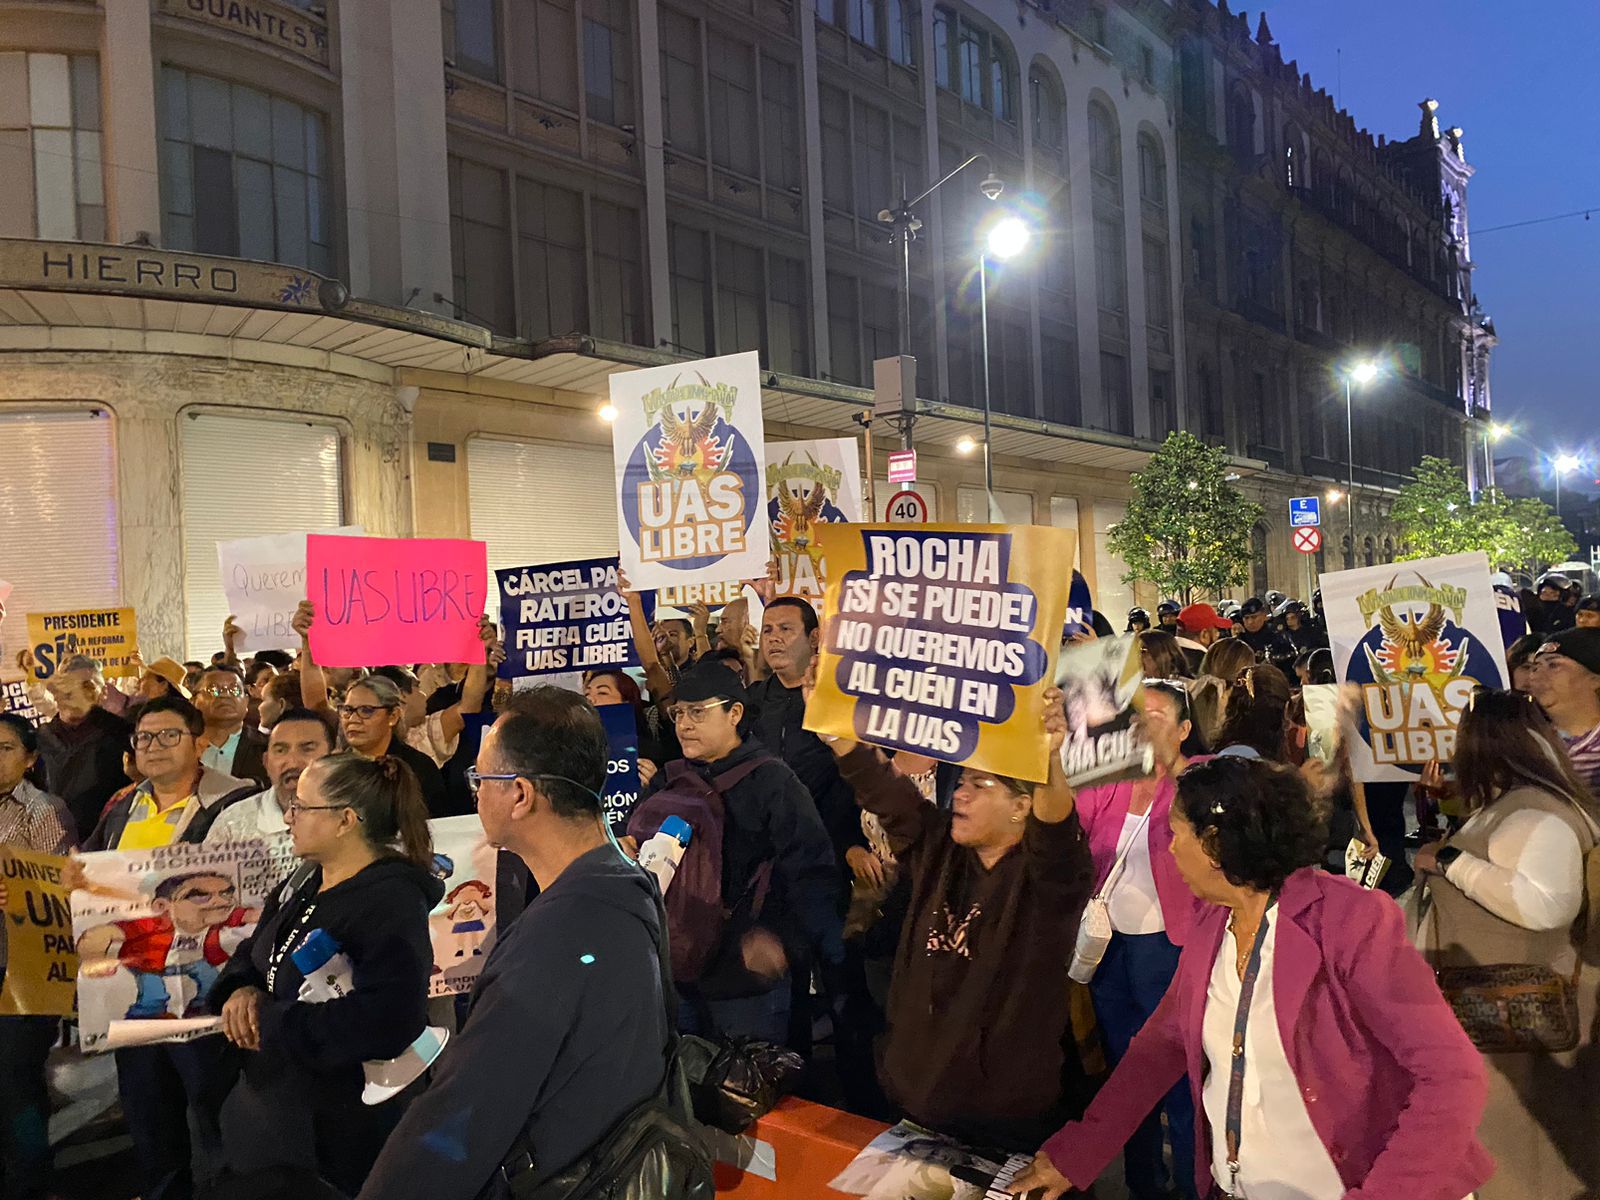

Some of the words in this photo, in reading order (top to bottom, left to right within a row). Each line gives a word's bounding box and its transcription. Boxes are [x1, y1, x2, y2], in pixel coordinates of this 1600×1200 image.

[43, 251, 238, 293] HIERRO
[638, 473, 744, 528] UAS
[895, 502, 917, 519] 40
[1300, 500, 1308, 509] E
[641, 521, 746, 562] LIBRE
[870, 536, 999, 585] ROCHA
[324, 568, 390, 625] UAS
[395, 569, 479, 624] LIBRE
[503, 569, 590, 597] CÁRCEL
[591, 566, 619, 588] PA
[659, 580, 743, 606] LIBRE
[44, 612, 121, 630] PRESIDENTE
[520, 592, 630, 624] RATEROS
[882, 582, 919, 619] SE
[923, 586, 1034, 633] PUEDE!
[88, 635, 125, 645] REFORMA
[93, 648, 106, 656] LEY
[516, 626, 581, 650] FUERA
[837, 619, 873, 652] NO
[875, 625, 1026, 677] QUEREMOS
[526, 649, 568, 671] UAS
[572, 642, 629, 666] LIBRE
[847, 661, 881, 695] AL
[885, 666, 957, 710] CUÉN
[959, 679, 999, 718] EN
[866, 705, 902, 741] LA
[904, 713, 963, 754] UAS
[1371, 729, 1458, 764] LIBR
[3, 858, 62, 885] UNIVE
[128, 847, 293, 873] DISCRIMINACI
[436, 975, 479, 986] PERDI
